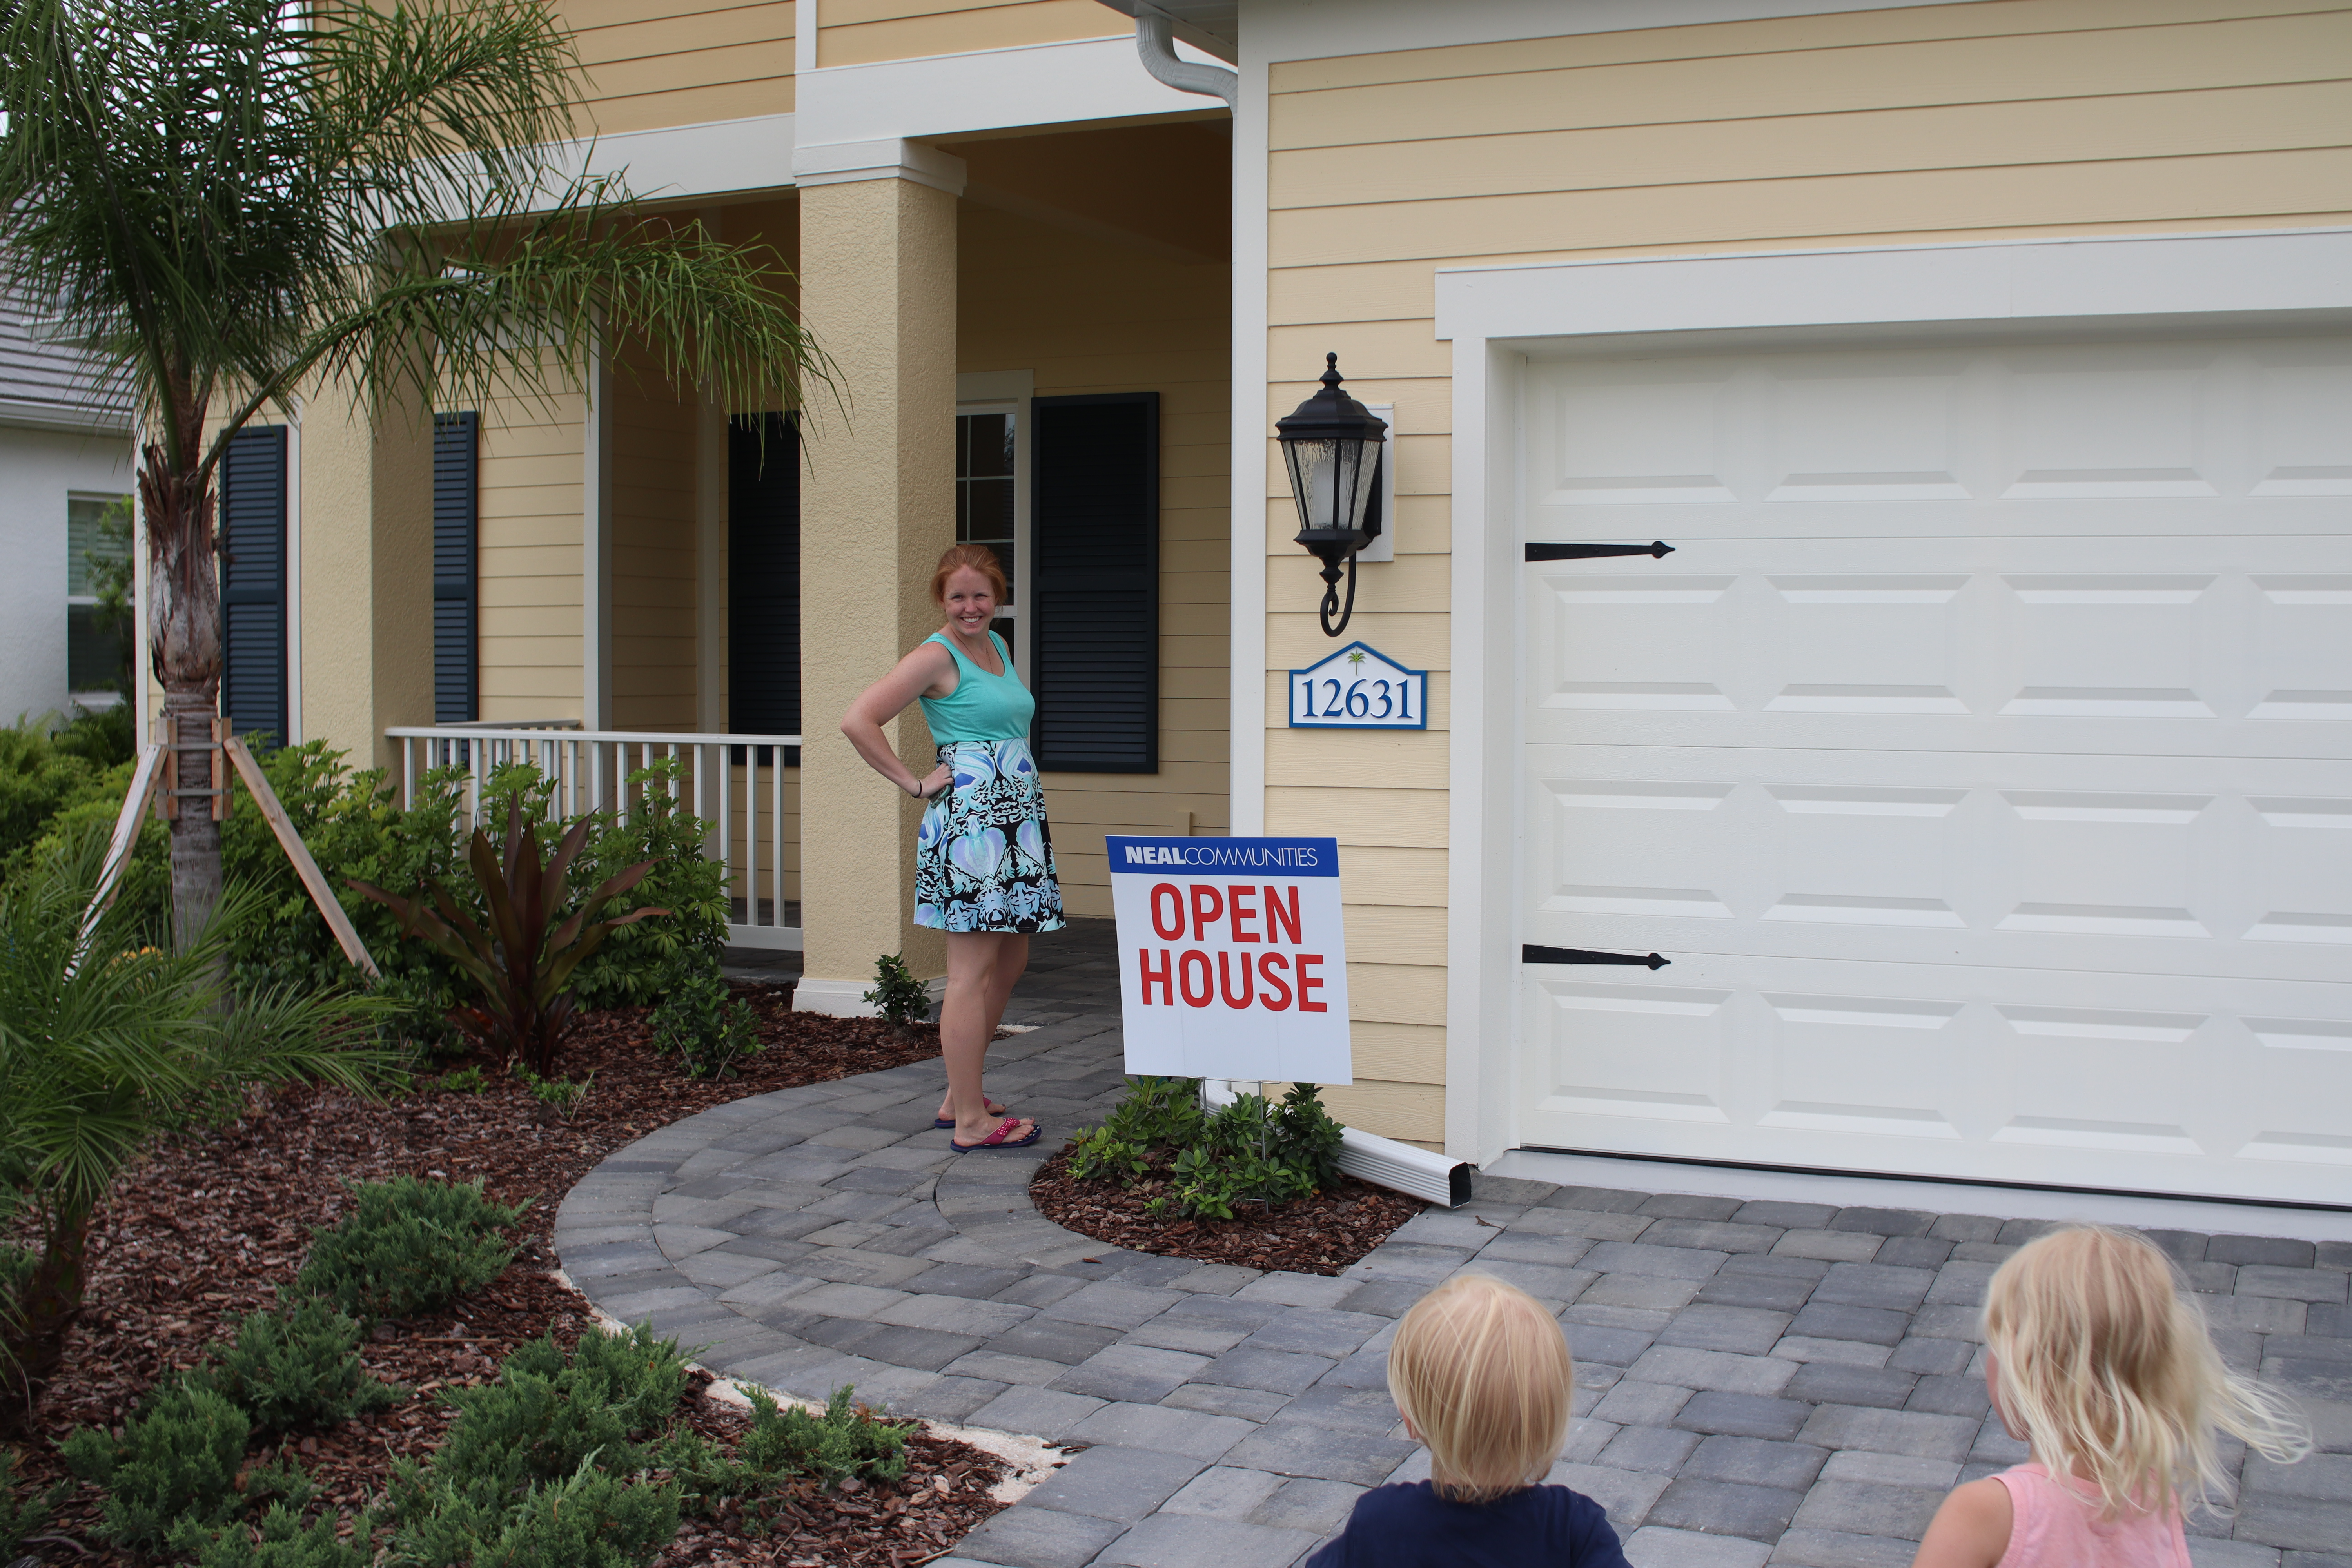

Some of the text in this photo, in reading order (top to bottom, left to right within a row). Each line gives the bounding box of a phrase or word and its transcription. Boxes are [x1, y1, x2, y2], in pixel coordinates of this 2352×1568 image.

[1302, 678, 1414, 718] 12631
[1150, 883, 1302, 944] OPEN
[1139, 948, 1327, 1013] HOUSE
